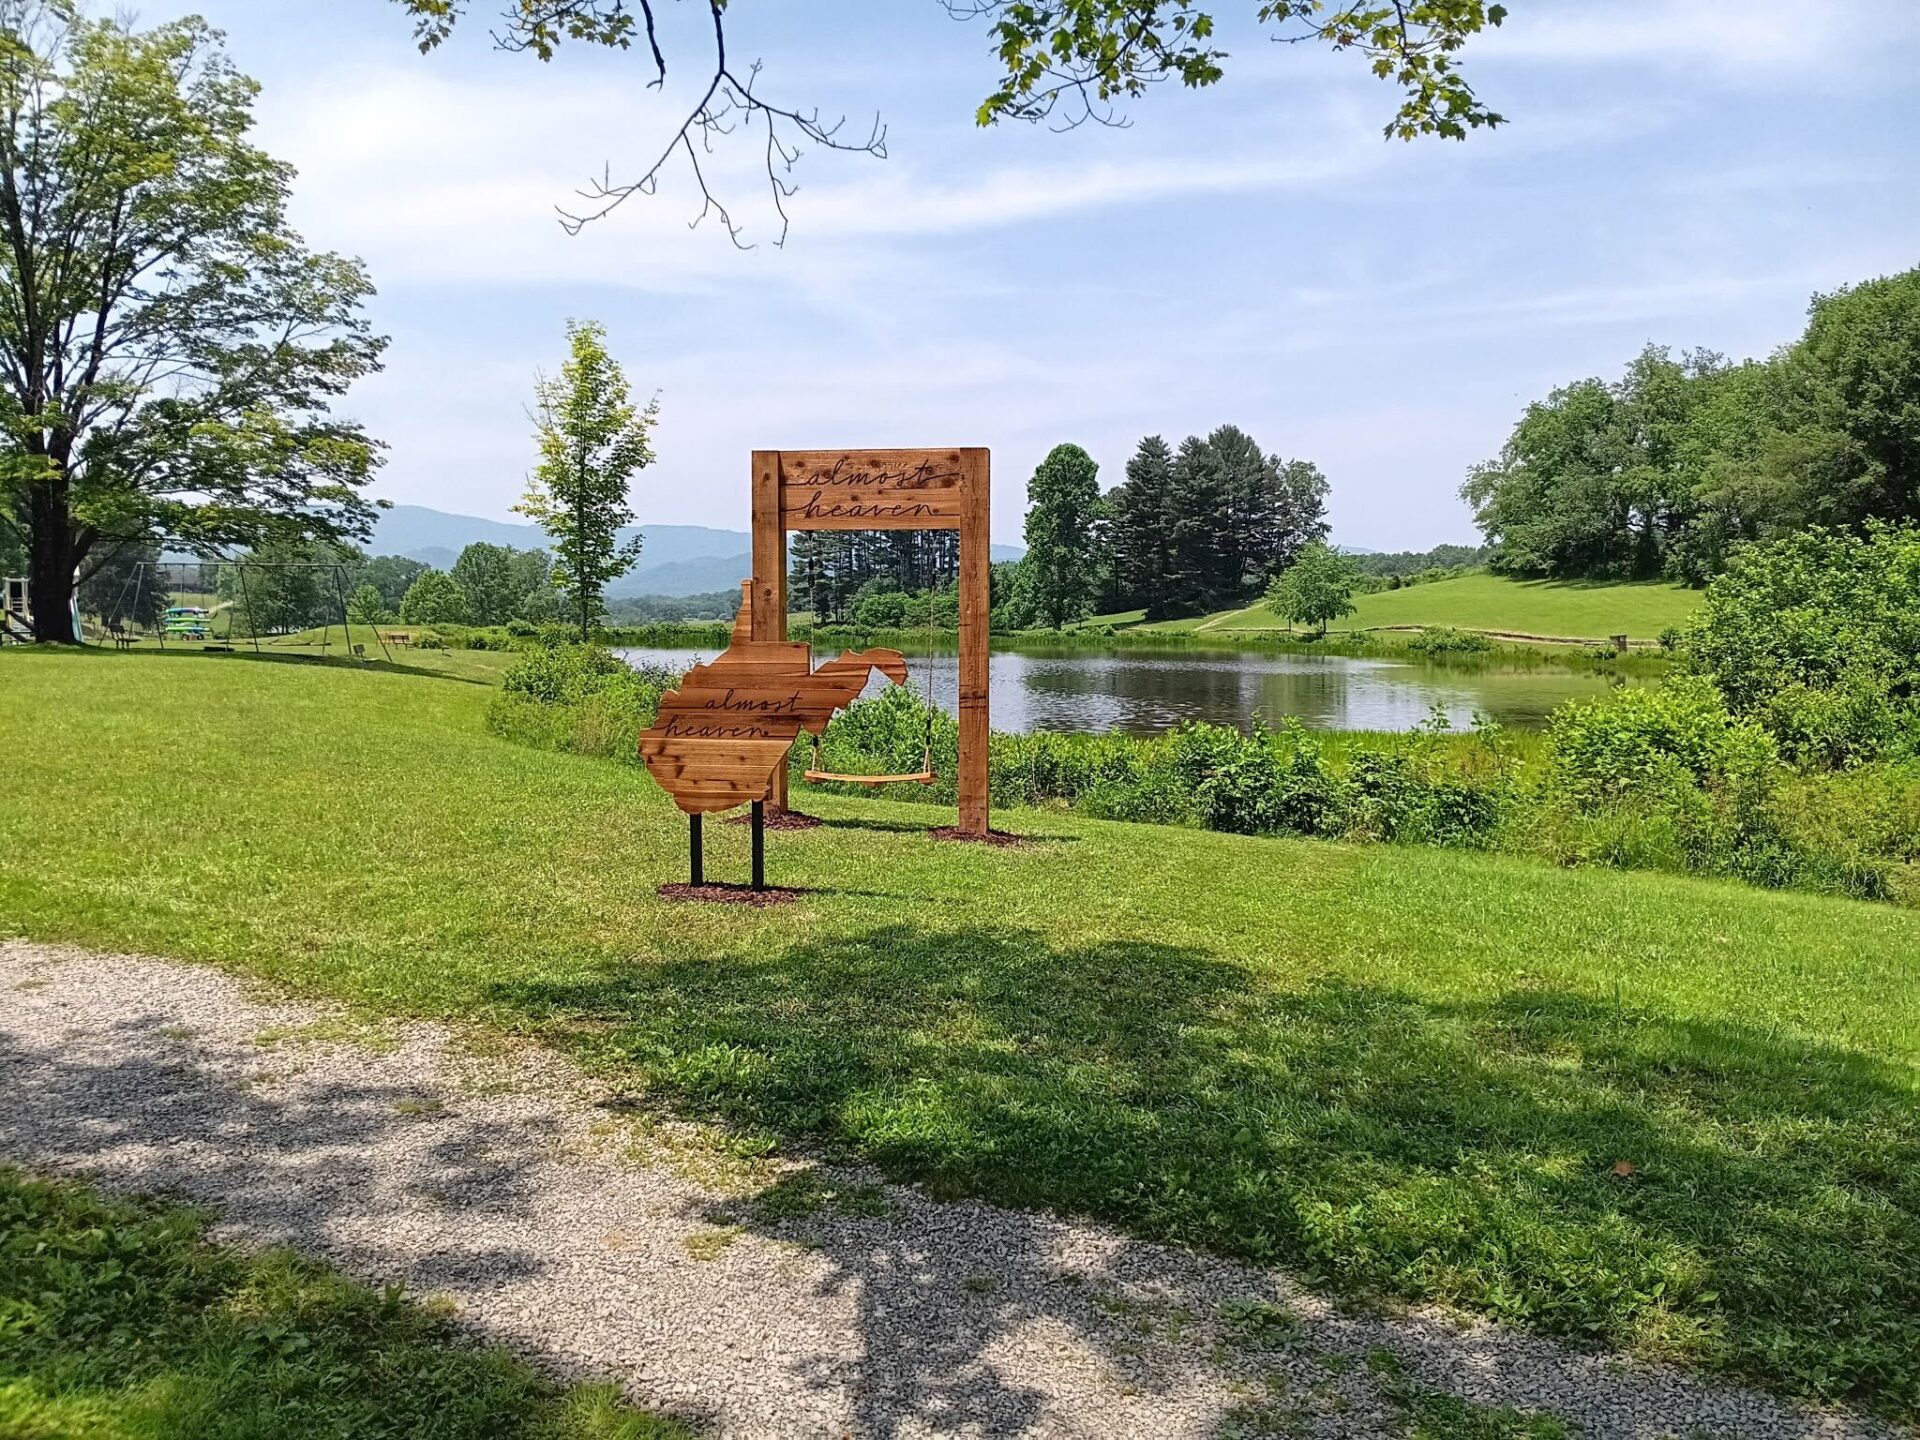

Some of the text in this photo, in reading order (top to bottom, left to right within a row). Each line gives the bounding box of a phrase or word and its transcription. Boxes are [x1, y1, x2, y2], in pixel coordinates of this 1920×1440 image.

[804, 459, 941, 486] almost
[799, 491, 936, 518] heaven
[704, 689, 804, 712] almost
[663, 715, 766, 737] heaven
